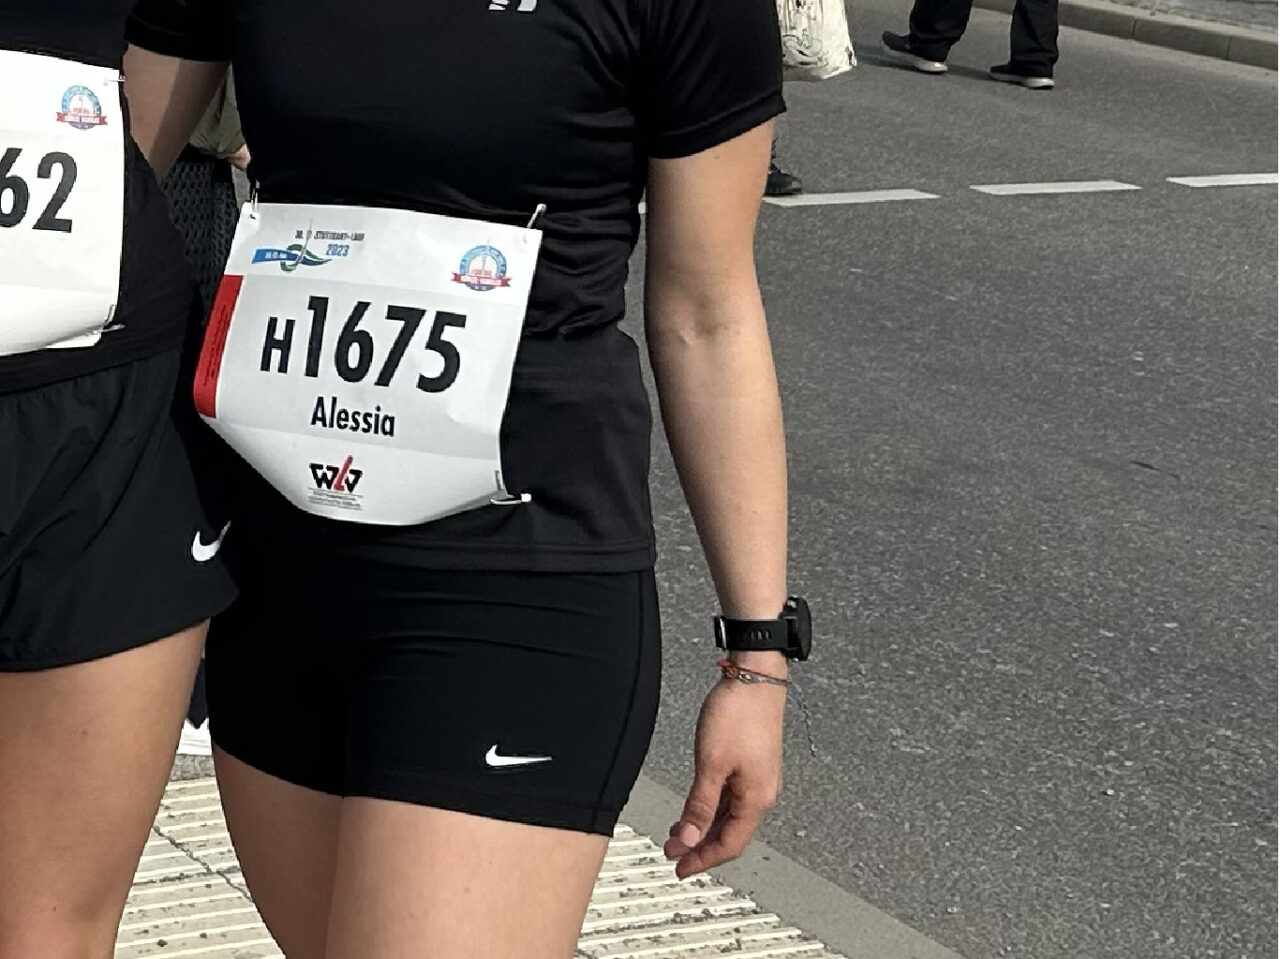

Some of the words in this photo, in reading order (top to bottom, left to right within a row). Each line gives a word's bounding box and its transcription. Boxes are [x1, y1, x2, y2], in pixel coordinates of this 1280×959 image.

[325, 243, 350, 257] 2023
[260, 295, 468, 394] H1675
[311, 395, 396, 438] Alessia
